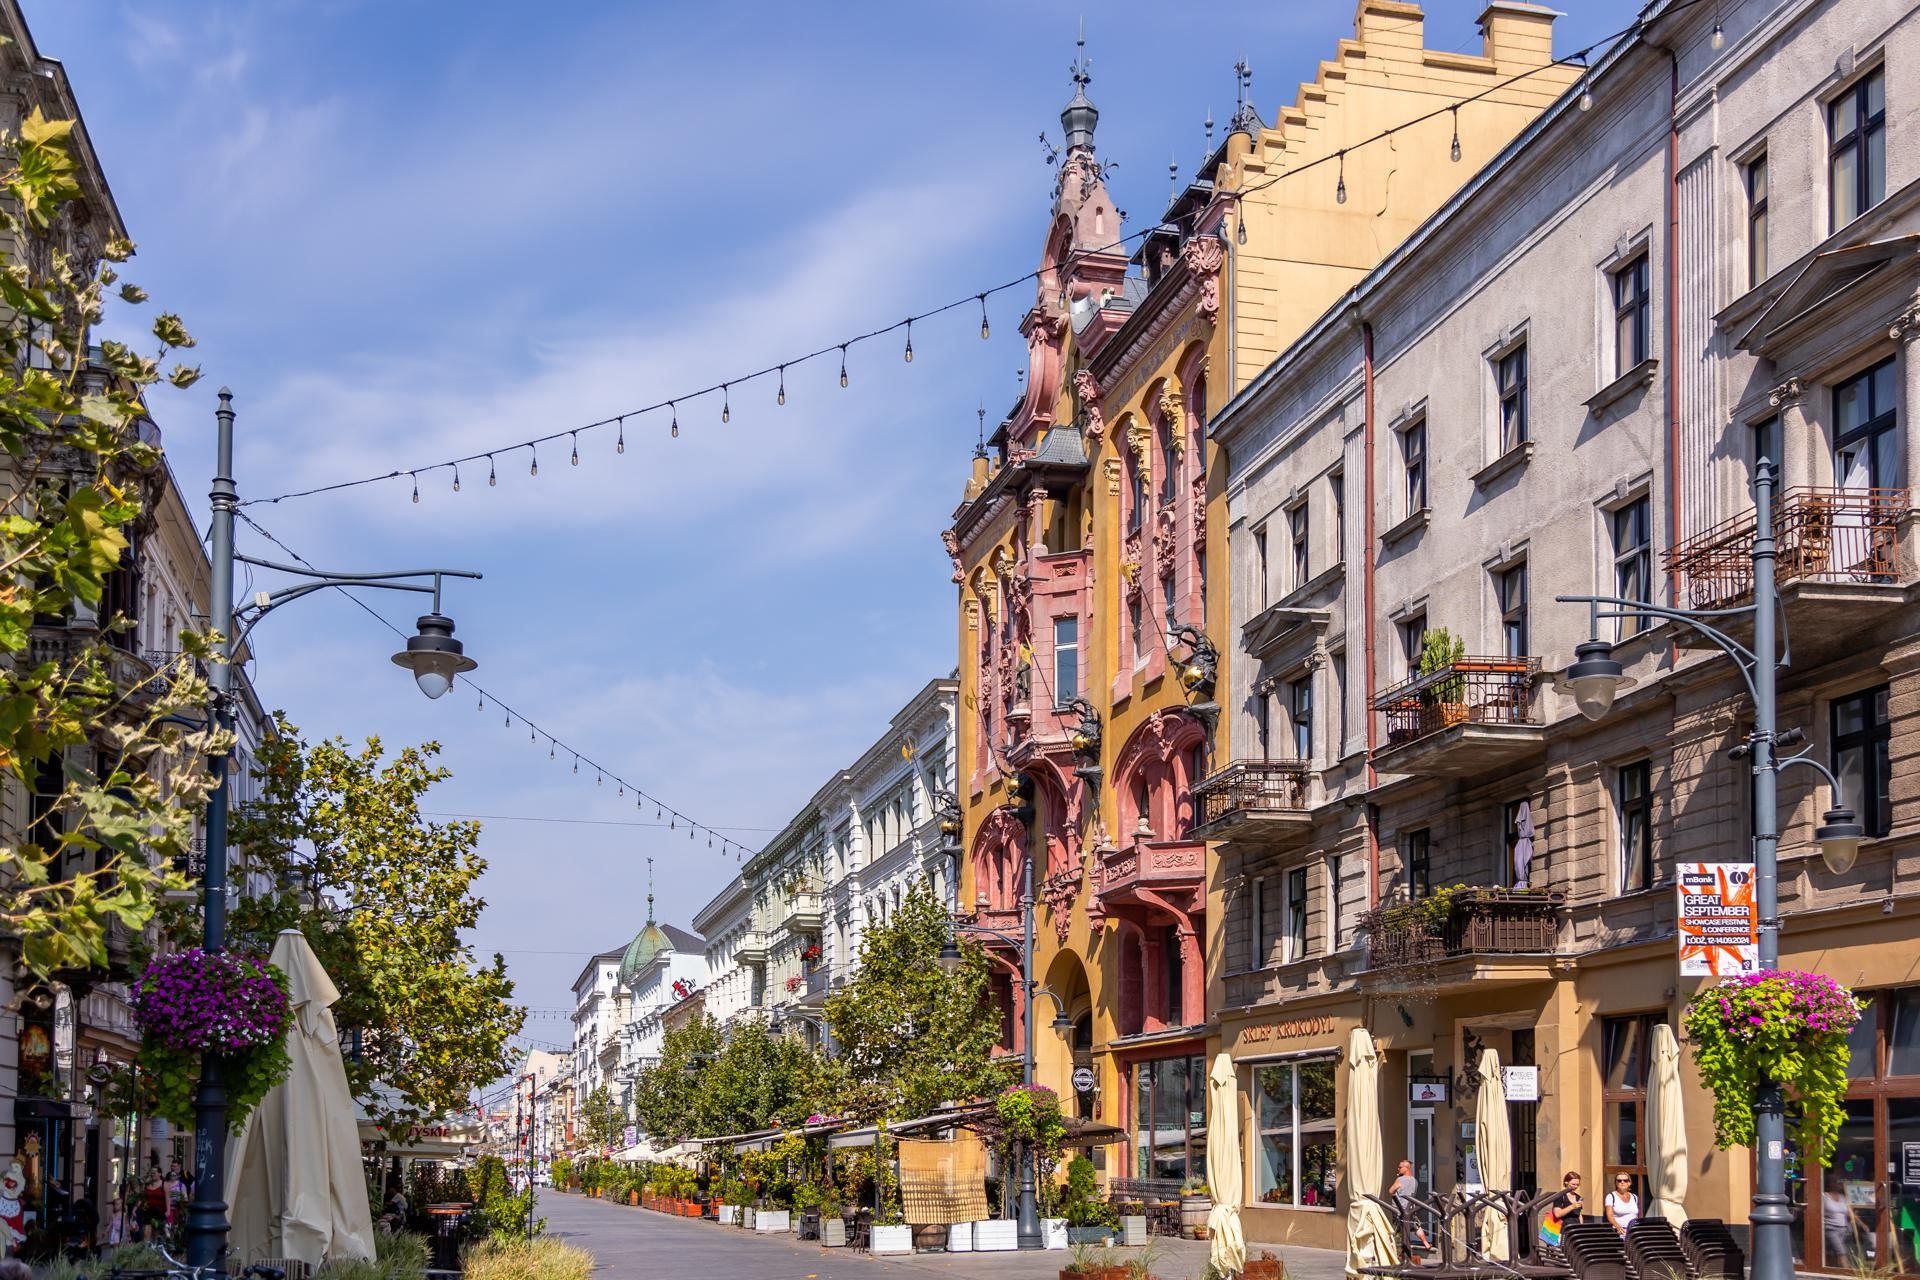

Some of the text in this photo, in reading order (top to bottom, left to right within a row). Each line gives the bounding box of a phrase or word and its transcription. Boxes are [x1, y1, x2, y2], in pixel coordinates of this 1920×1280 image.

[1685, 895, 1720, 905] GREAT
[1685, 906, 1750, 916] SEPTEMBER
[1243, 1015, 1335, 1044] SKLEP KROKODYL
